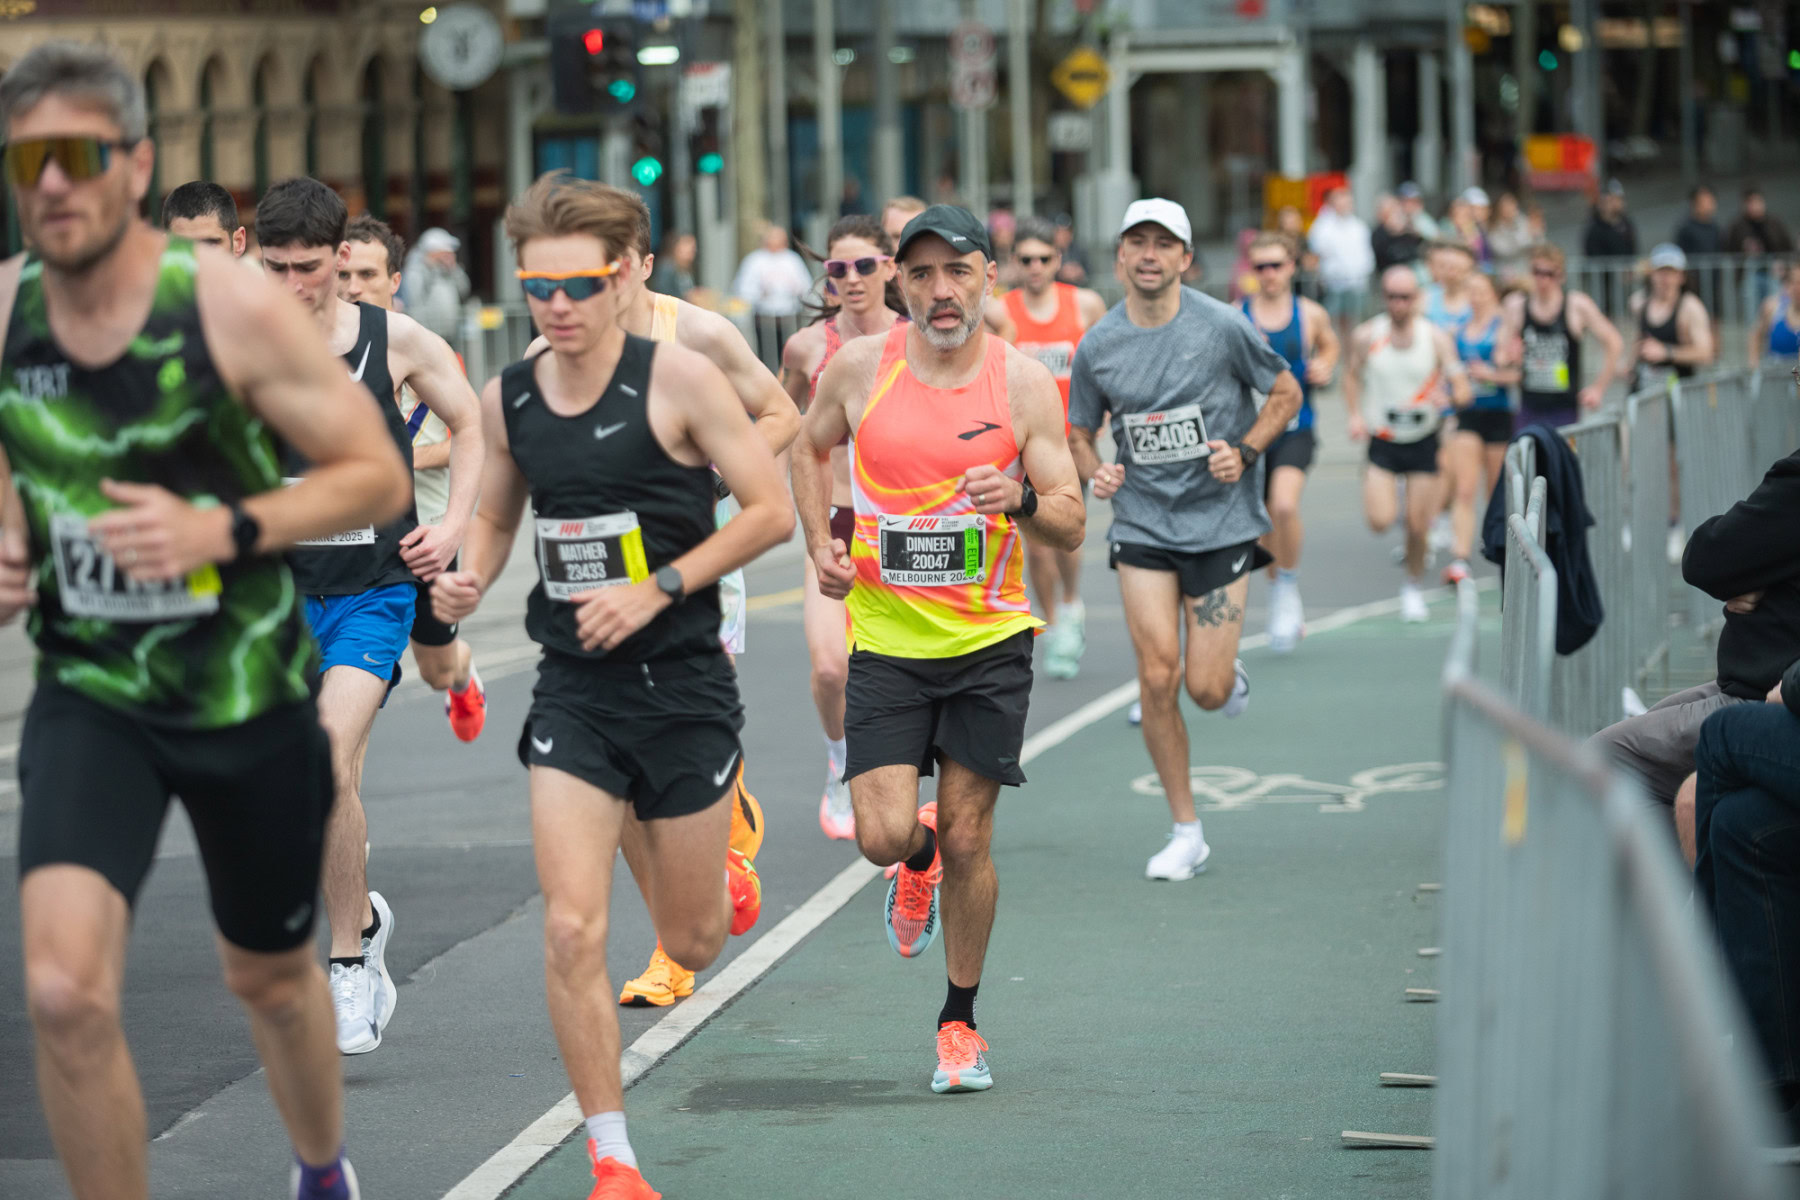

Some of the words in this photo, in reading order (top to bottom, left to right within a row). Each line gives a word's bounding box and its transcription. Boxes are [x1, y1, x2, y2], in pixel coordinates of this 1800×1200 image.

[1133, 420, 1199, 452] 25406
[339, 531, 364, 542] 2025
[906, 536, 955, 552] DINNEEN
[558, 541, 608, 562] MATHER
[912, 553, 950, 570] 20047
[967, 547, 978, 576] ELITE
[566, 561, 607, 581] 23433
[888, 571, 947, 583] MELBOURNE
